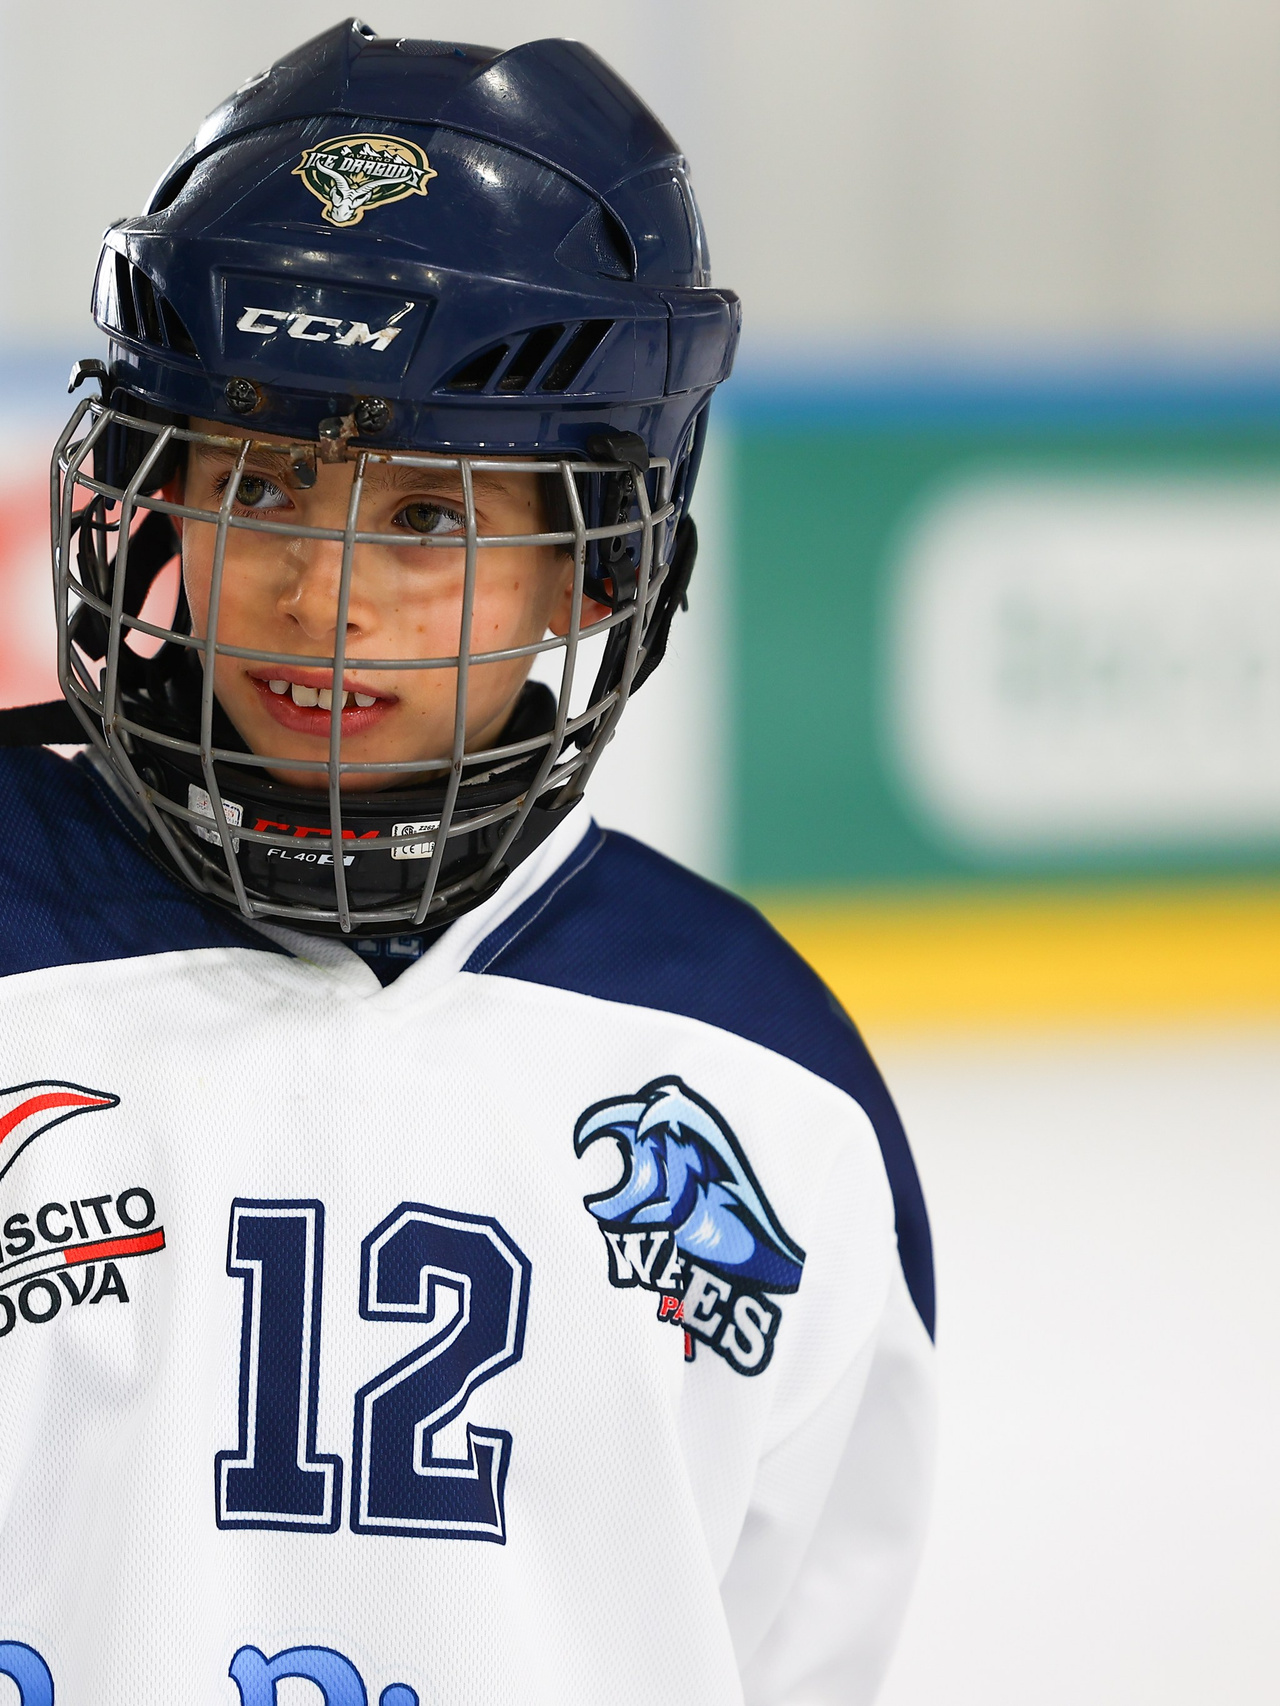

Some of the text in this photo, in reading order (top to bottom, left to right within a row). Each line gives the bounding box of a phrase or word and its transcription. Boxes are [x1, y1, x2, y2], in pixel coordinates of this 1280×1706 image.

[338, 157, 425, 187] DRAGONS
[348, 152, 392, 163] AVIANO
[236, 306, 402, 352] CCM
[267, 848, 317, 863] FL40
[214, 1197, 532, 1546] 12
